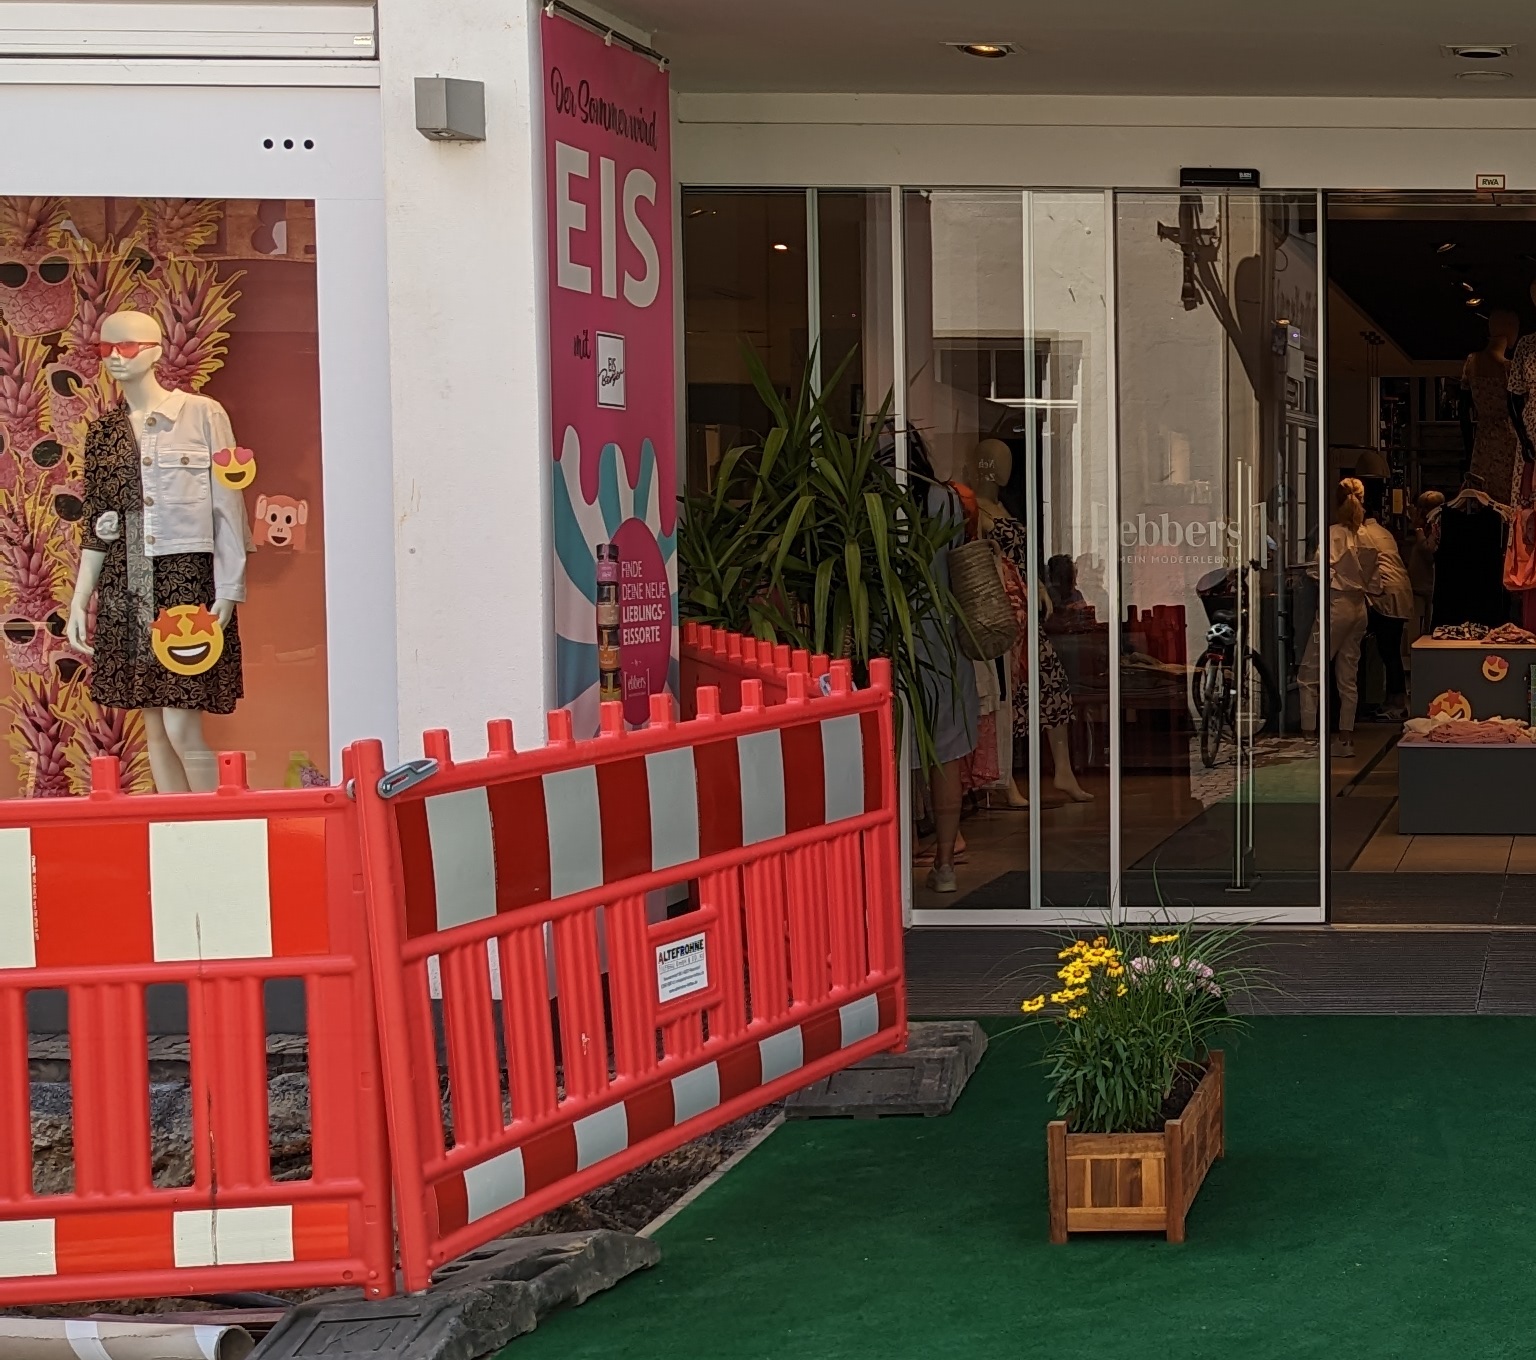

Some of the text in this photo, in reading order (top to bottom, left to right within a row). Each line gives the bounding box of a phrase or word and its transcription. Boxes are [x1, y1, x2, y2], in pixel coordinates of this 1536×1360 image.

[551, 66, 658, 152] Der Sommer wird
[555, 139, 660, 309] EIS
[1121, 512, 1242, 547] ebbers
[621, 561, 643, 578] FINDE
[622, 581, 667, 601] DEINE NEUE
[622, 604, 666, 623] LIEBLINGS-
[622, 625, 661, 646] EISSORTE
